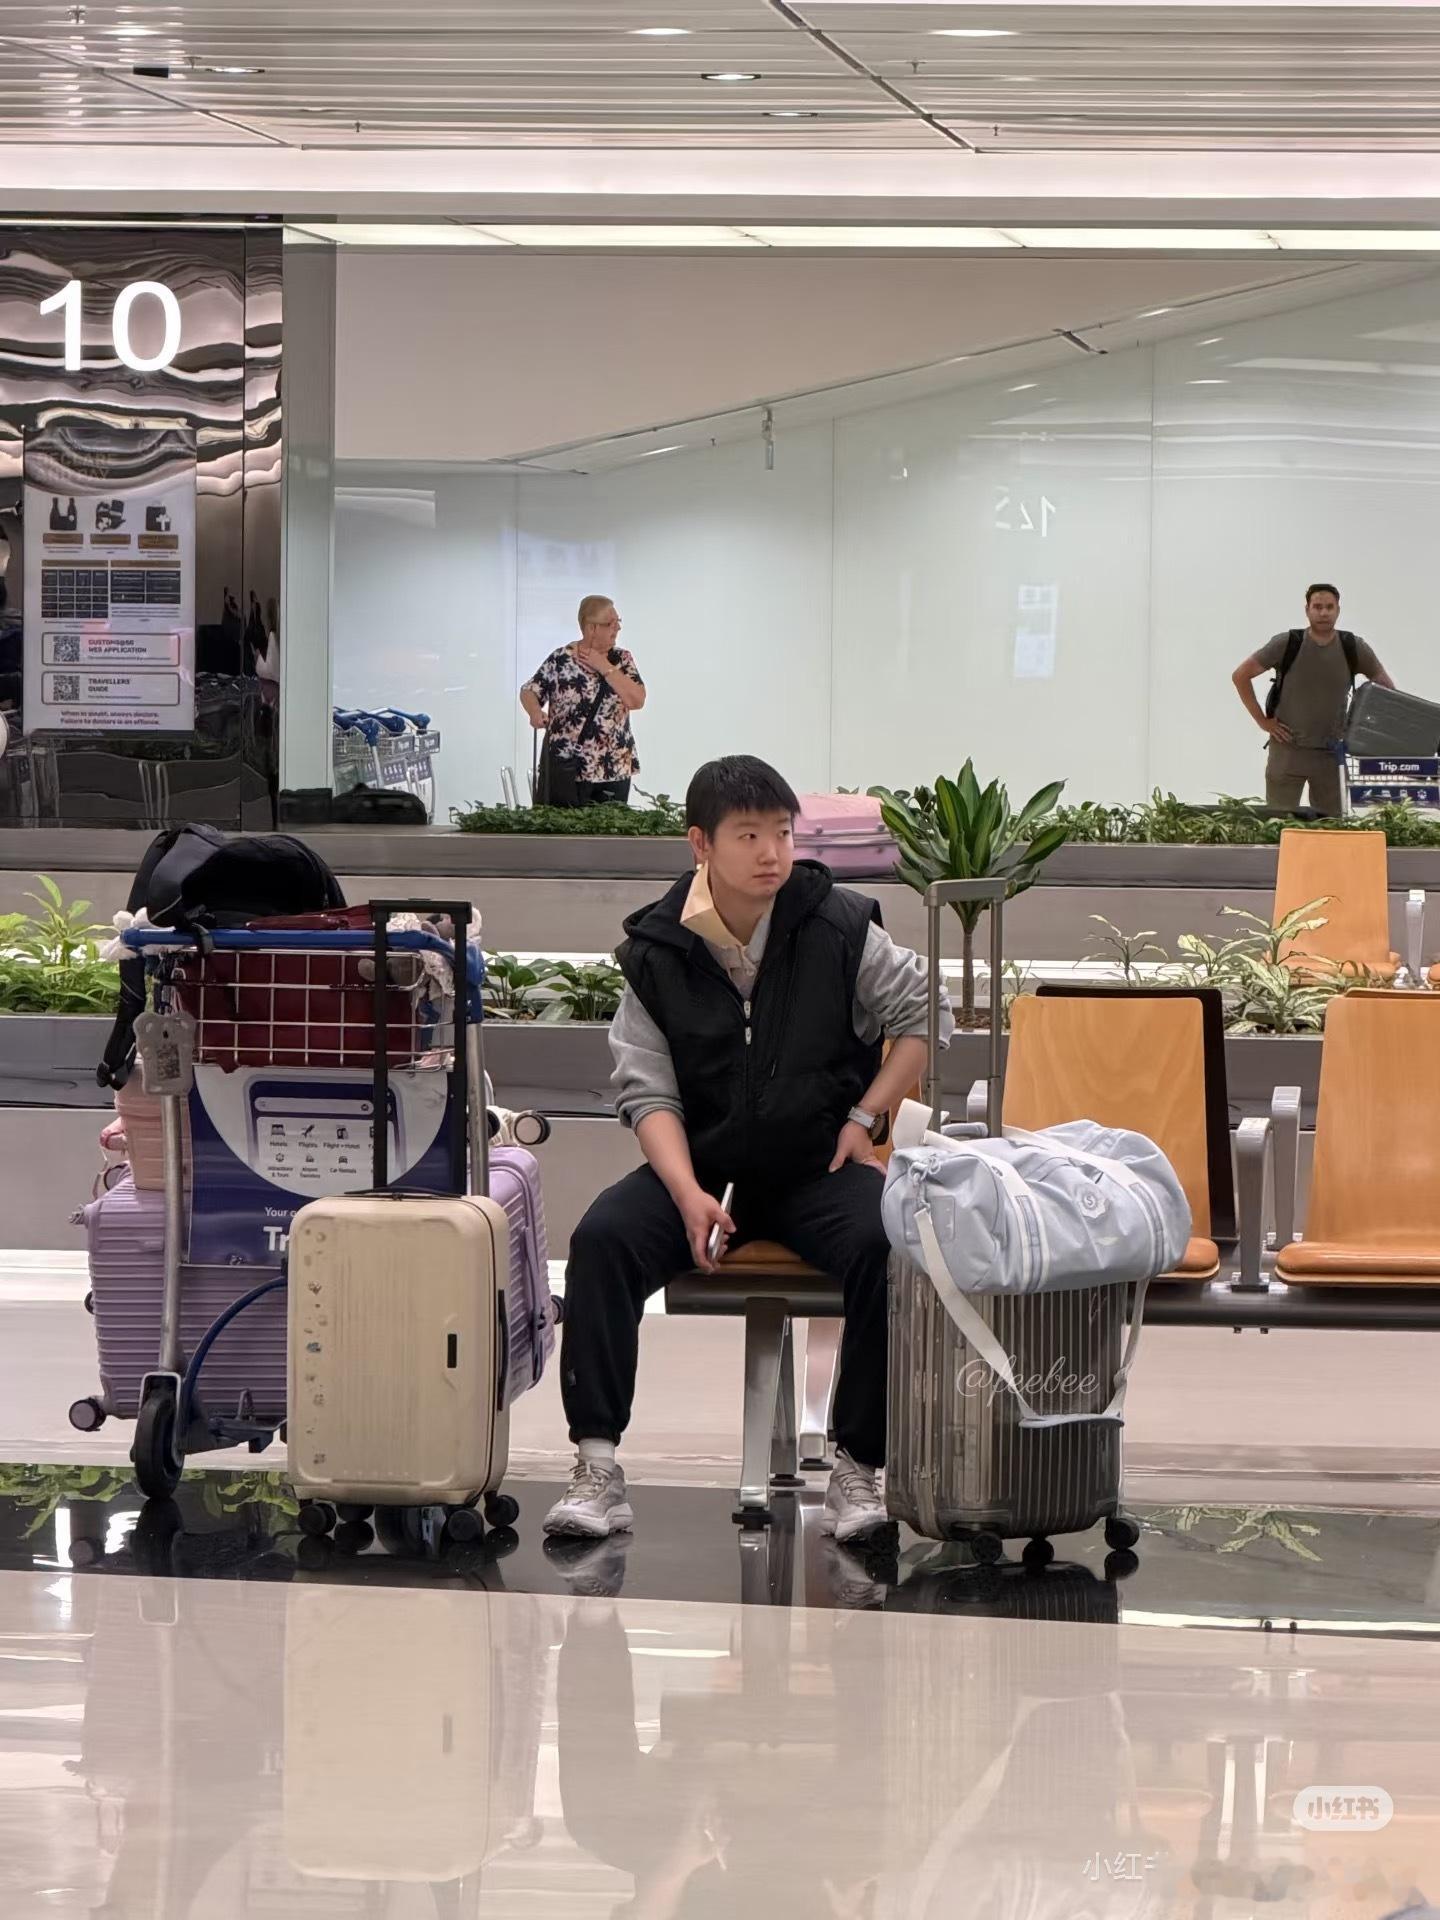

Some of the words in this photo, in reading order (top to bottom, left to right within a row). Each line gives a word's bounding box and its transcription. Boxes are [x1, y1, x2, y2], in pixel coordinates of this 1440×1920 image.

[39, 279, 182, 372] 10
[1378, 761, 1420, 773] Trip.com
[264, 1206, 288, 1217] Your
